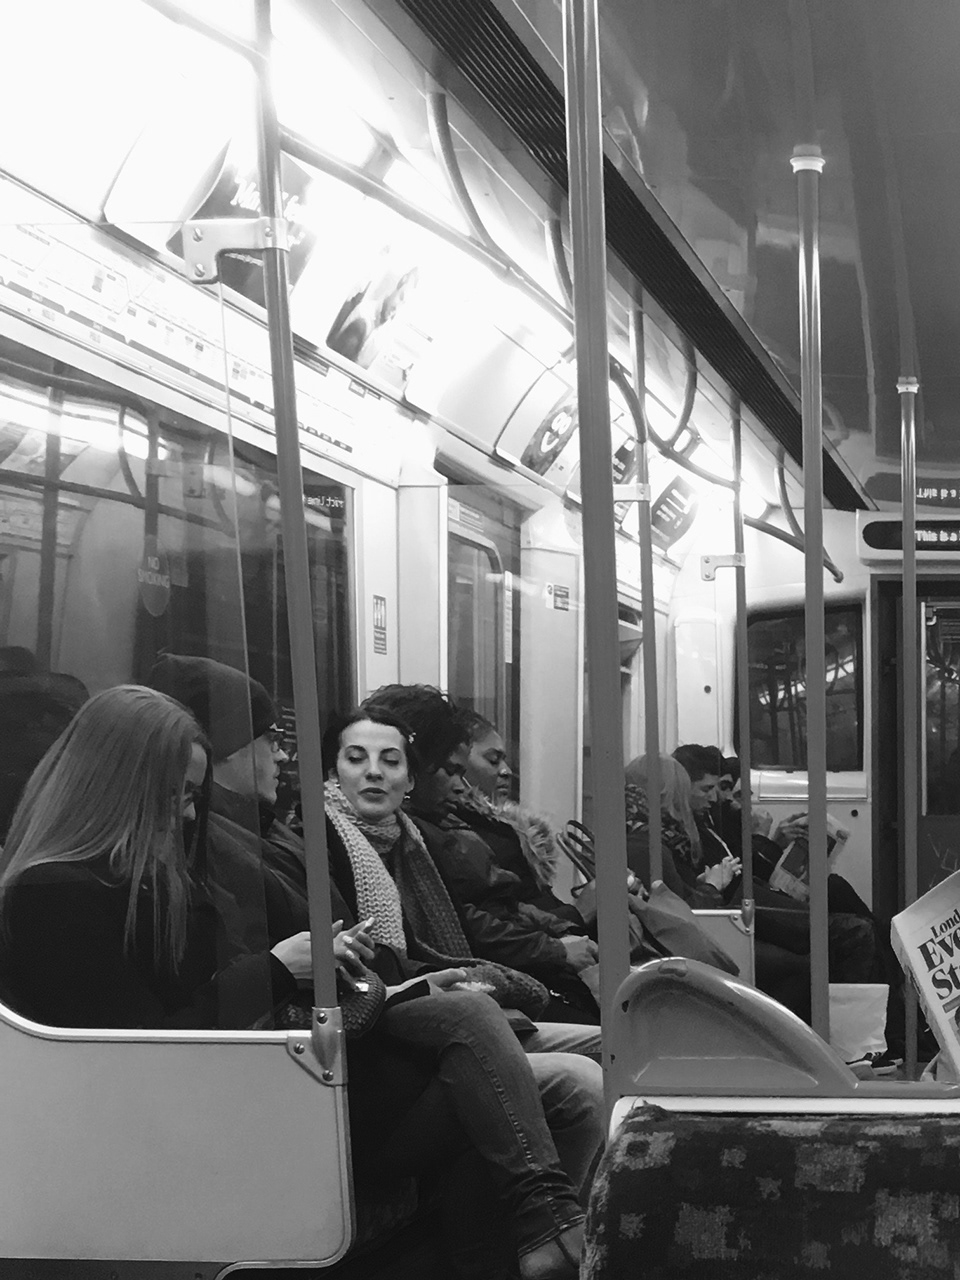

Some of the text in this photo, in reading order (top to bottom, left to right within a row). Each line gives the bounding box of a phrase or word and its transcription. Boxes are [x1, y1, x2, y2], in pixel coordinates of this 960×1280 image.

[914, 529, 938, 542] This
[940, 529, 949, 542] is
[949, 532, 957, 542] a
